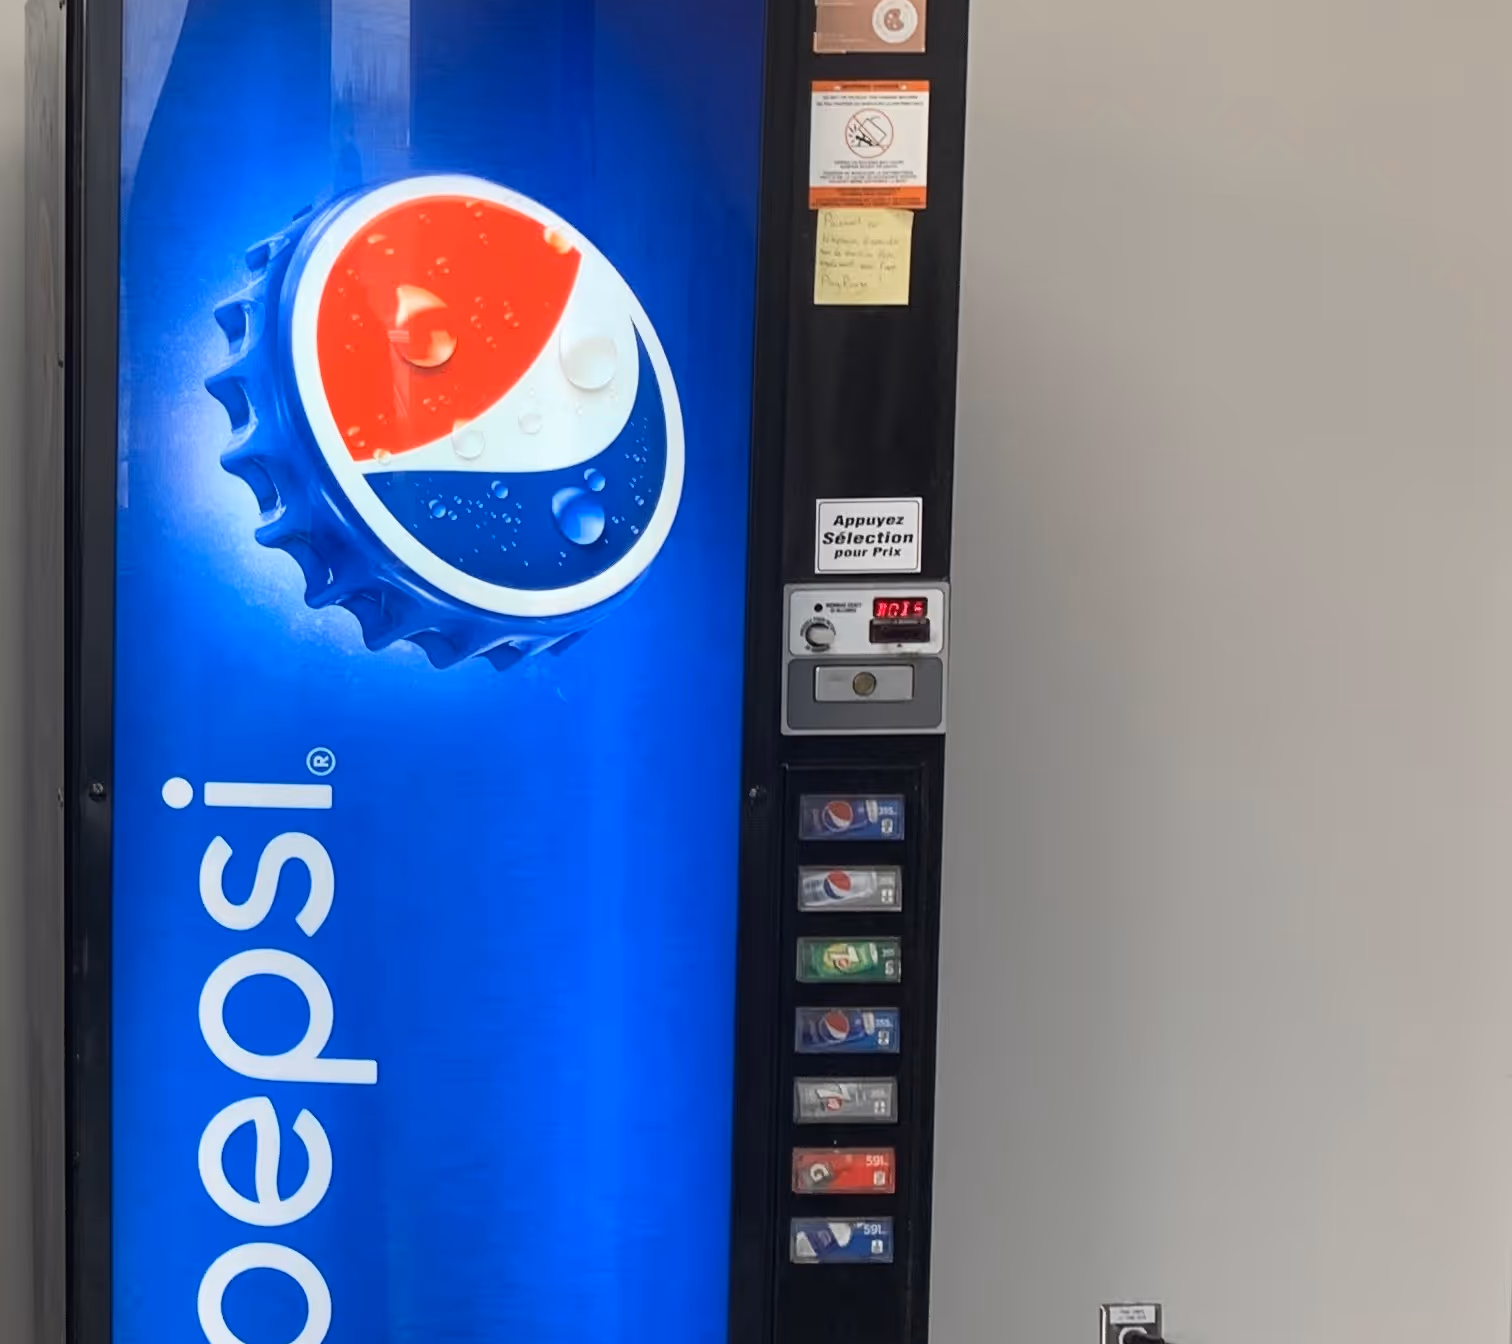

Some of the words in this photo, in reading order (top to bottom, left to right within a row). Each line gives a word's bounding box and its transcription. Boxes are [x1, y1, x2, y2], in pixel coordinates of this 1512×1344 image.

[833, 515, 905, 528] Appuyez
[822, 531, 914, 545] Sélection
[834, 548, 868, 559] pour
[872, 547, 902, 557] Prix
